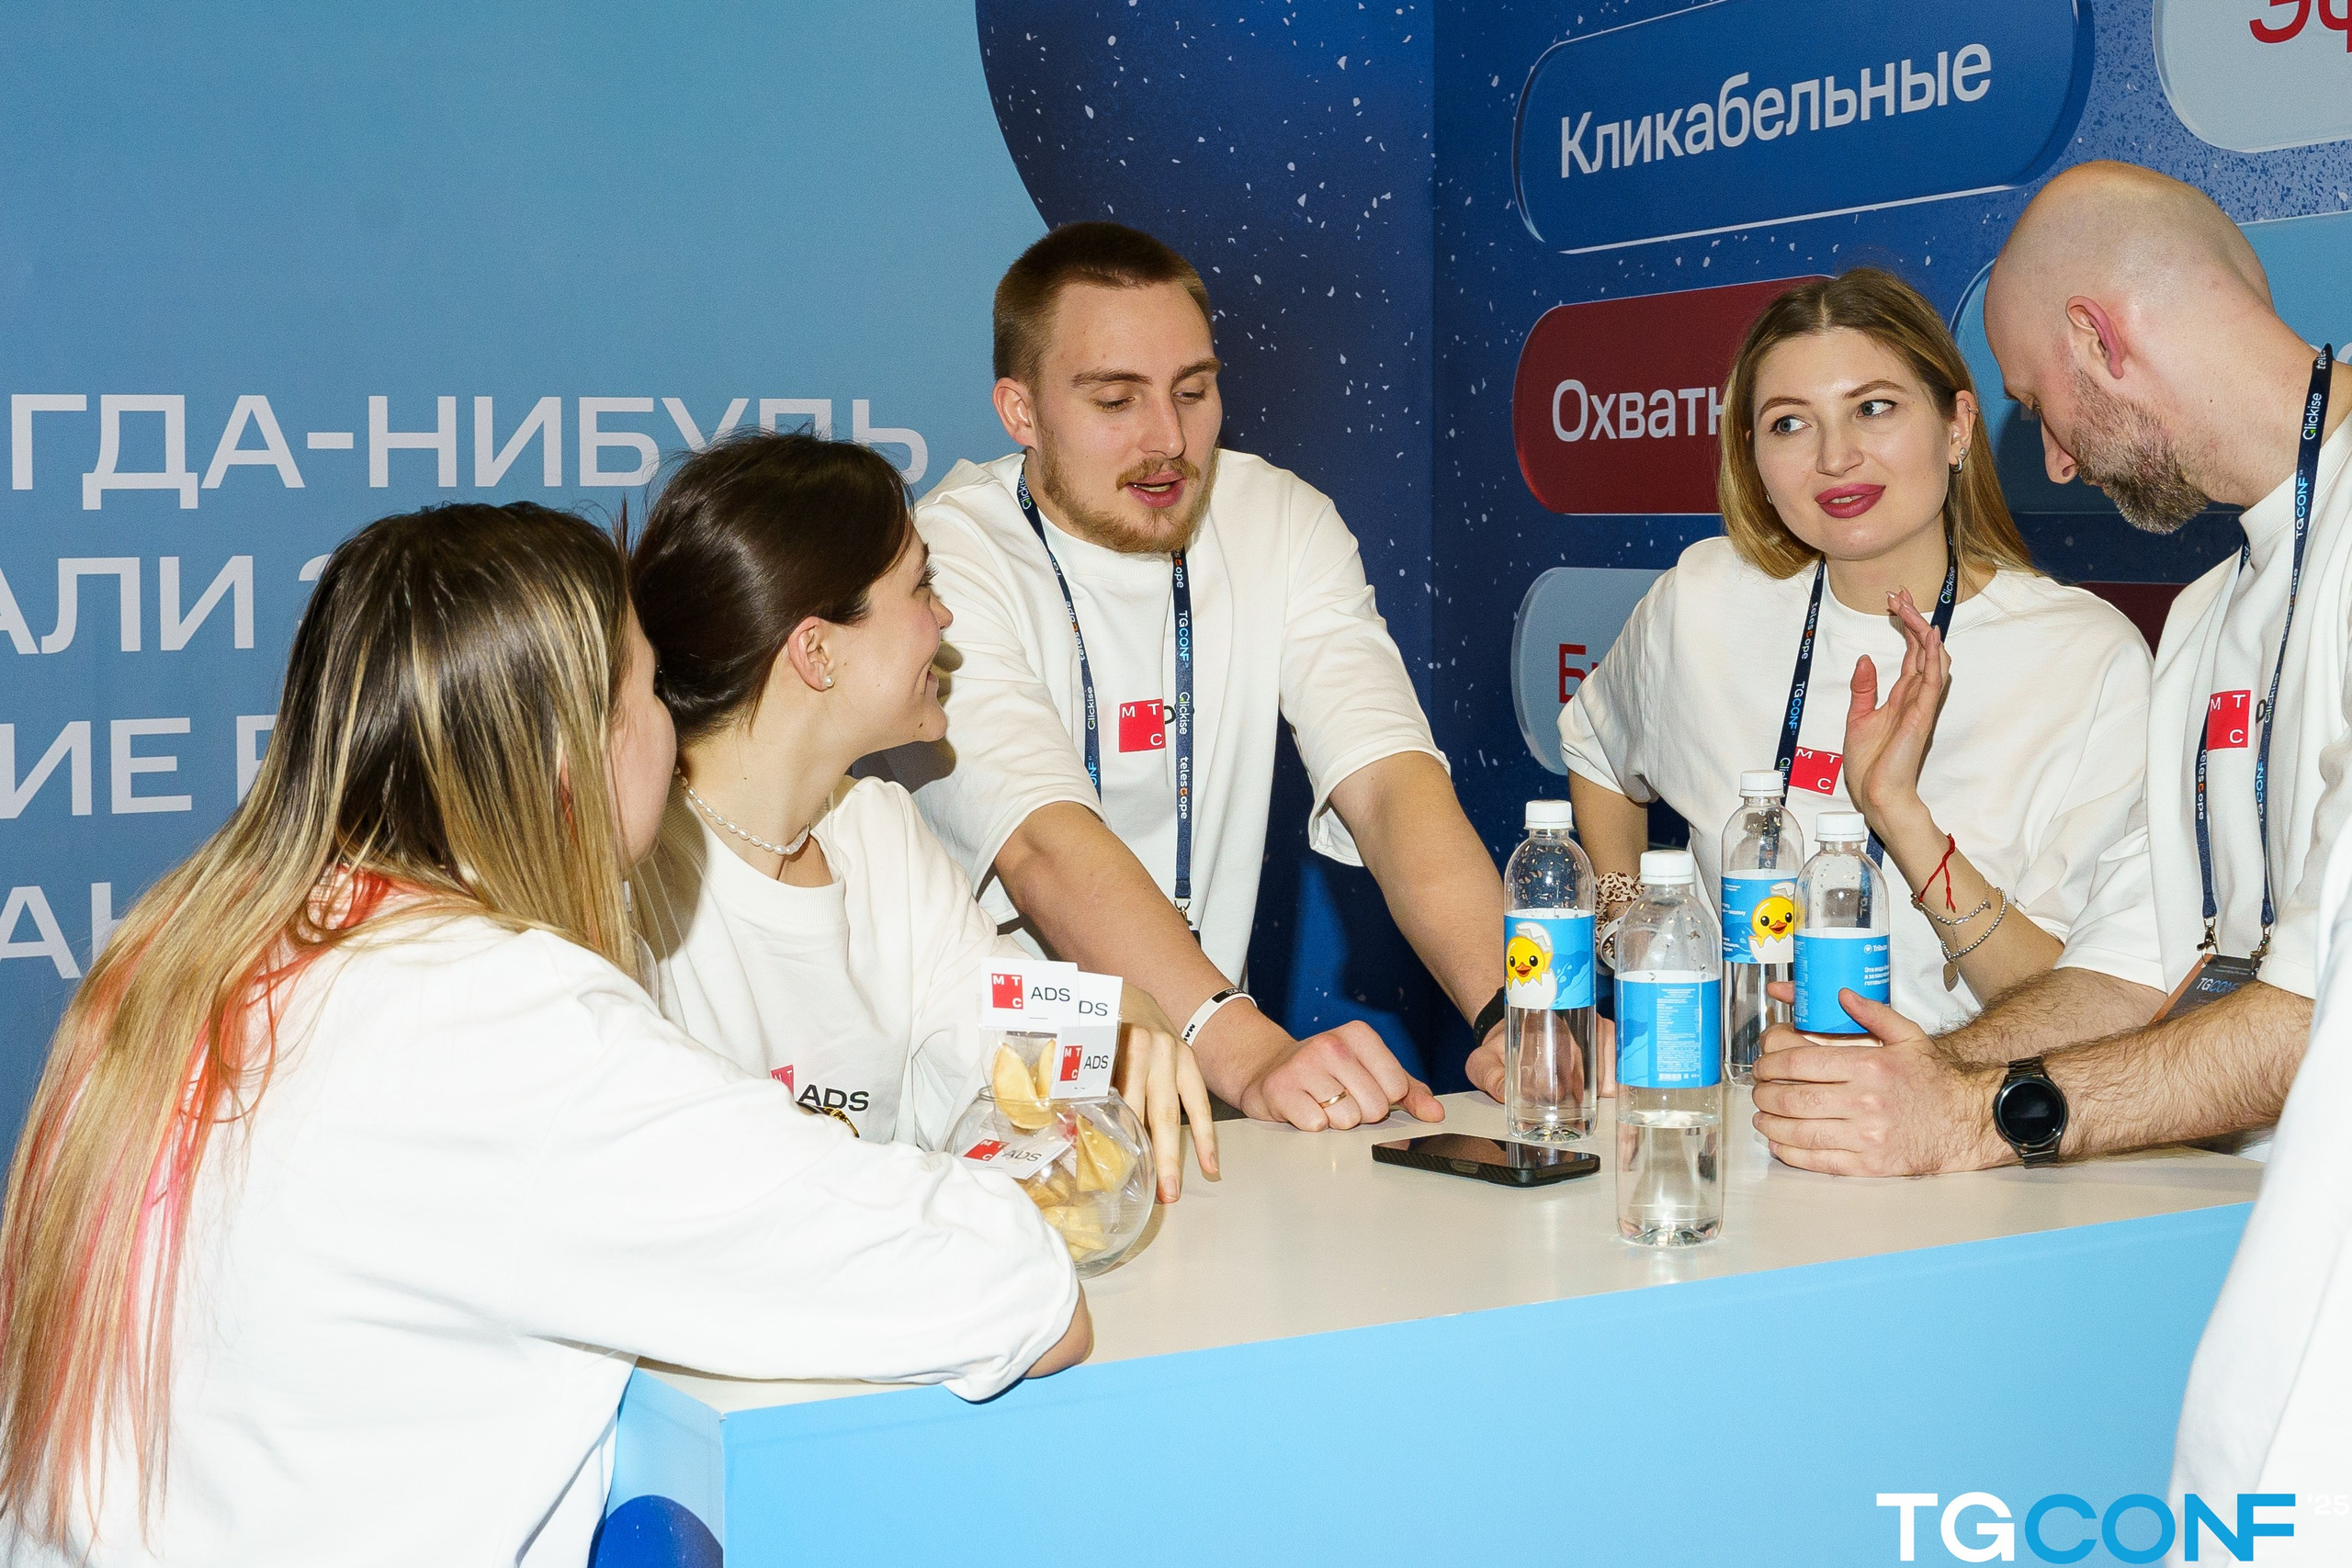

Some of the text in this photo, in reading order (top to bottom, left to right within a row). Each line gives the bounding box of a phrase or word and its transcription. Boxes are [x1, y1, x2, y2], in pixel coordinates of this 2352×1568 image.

[1561, 42, 1992, 178] Кликабельные
[2302, 392, 2323, 441] Clickise
[2296, 476, 2309, 539] TGCONF
[1939, 566, 1956, 604] Clickise
[1178, 610, 1190, 661] TGCONF
[1801, 602, 1818, 660] telescope
[1087, 686, 1096, 730] Clickise
[1179, 692, 1191, 735] Clickise
[1788, 681, 1805, 730] TGCONF
[1179, 756, 1190, 820] telescope
[2198, 749, 2208, 820] telescope
[1031, 987, 1070, 1002] ADS
[1083, 1055, 1109, 1070] ADS
[797, 1084, 870, 1111] ADS
[1001, 1149, 1043, 1162] ADS
